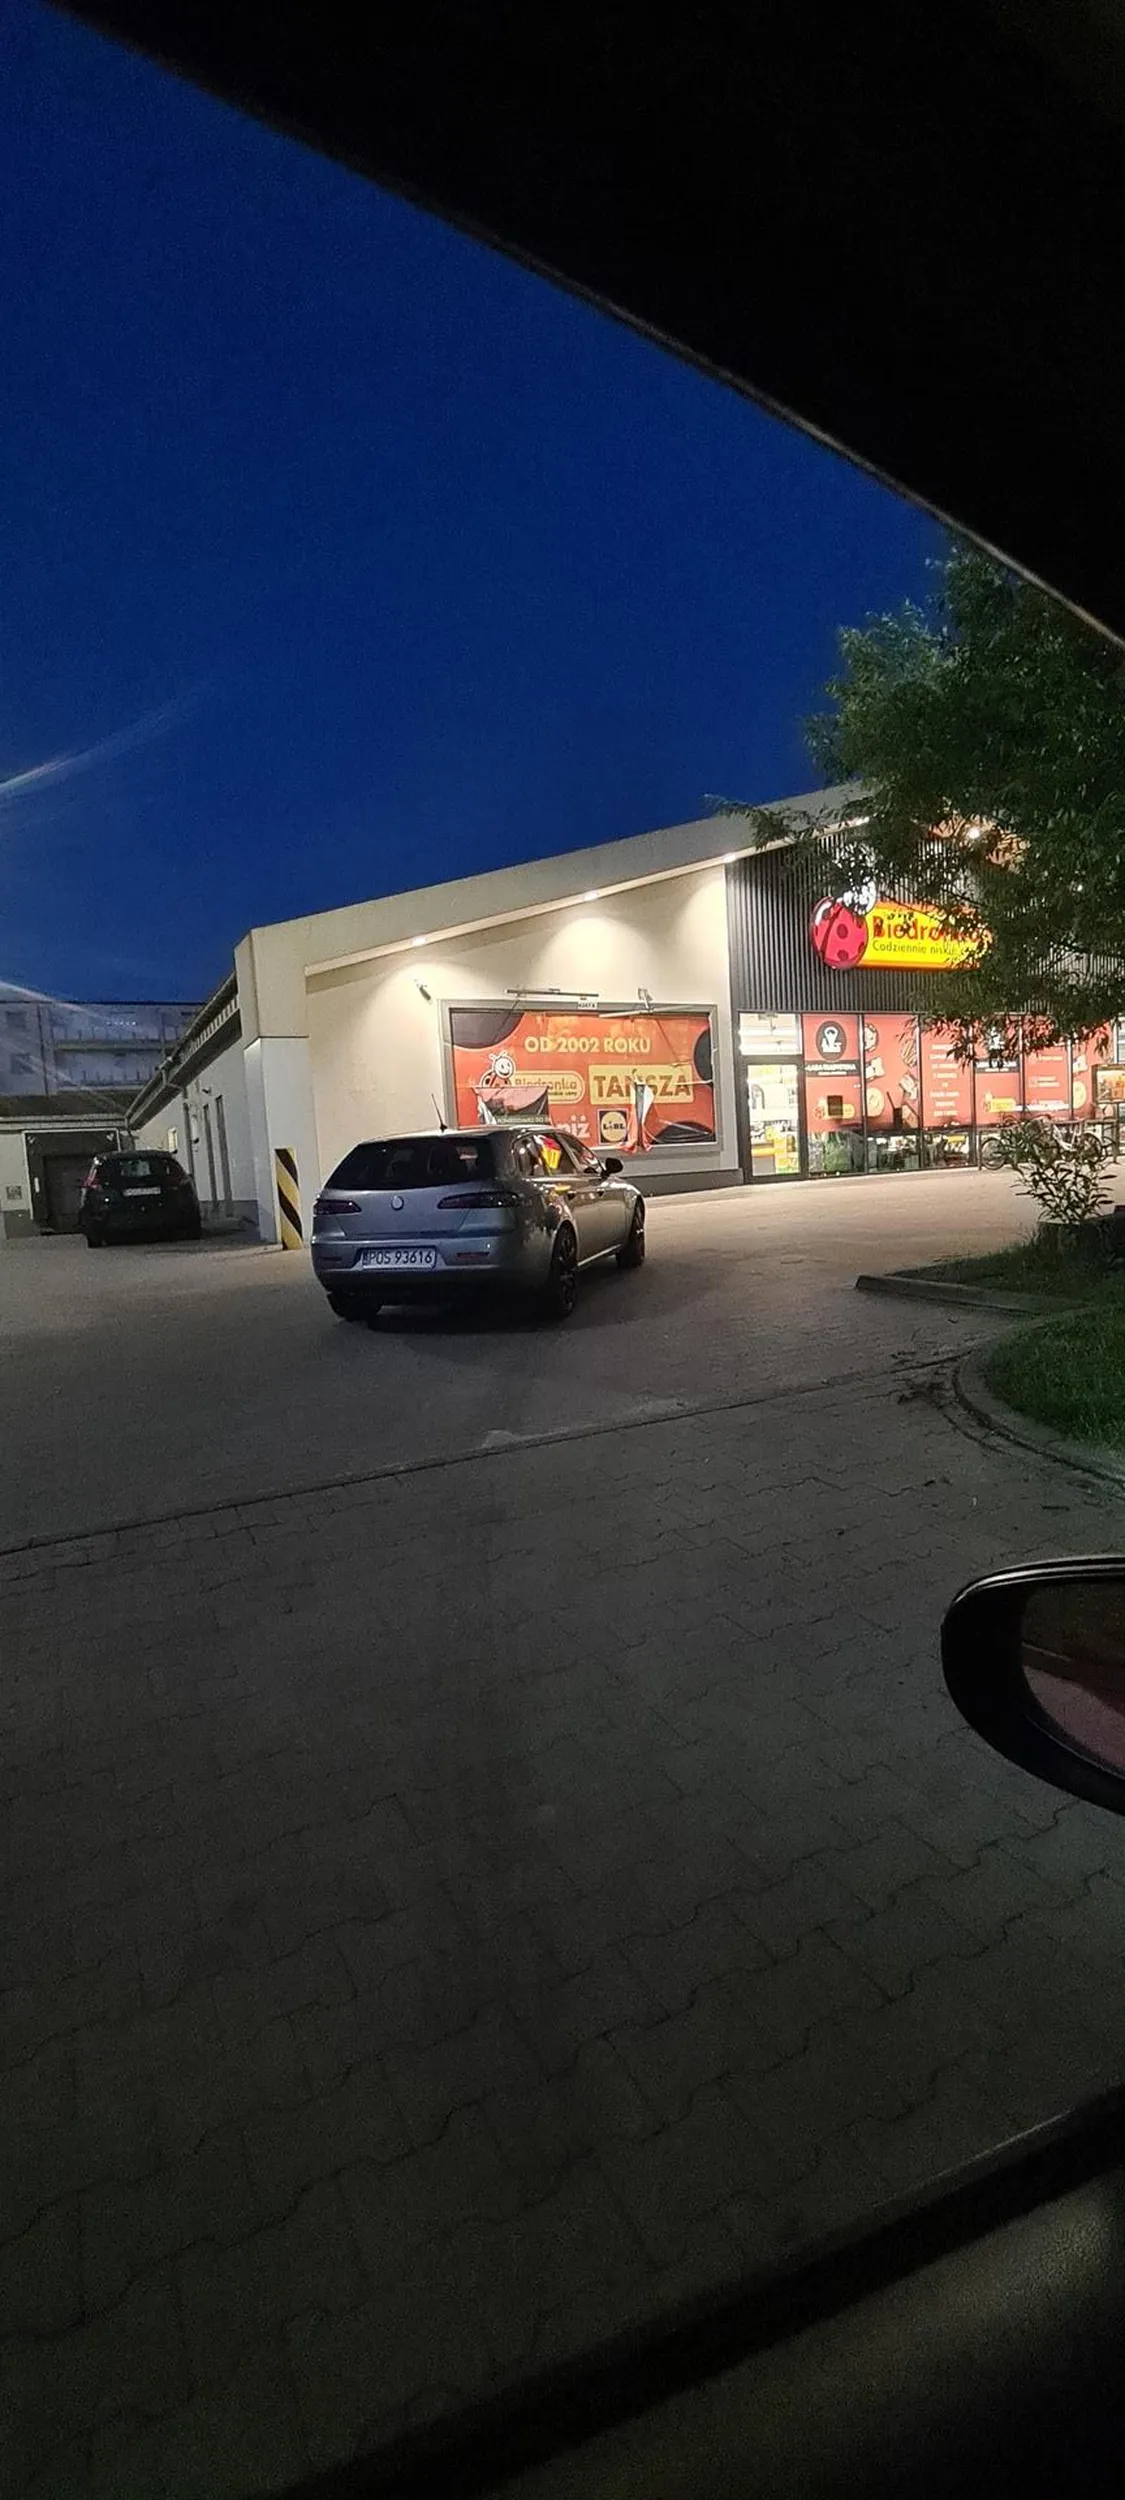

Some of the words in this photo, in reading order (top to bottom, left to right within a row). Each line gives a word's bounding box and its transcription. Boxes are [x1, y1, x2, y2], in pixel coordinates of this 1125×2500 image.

[872, 940, 926, 955] Codziennie
[524, 1036, 554, 1053] OD
[557, 1036, 600, 1053] 2002
[603, 1036, 651, 1053] ROKU
[370, 1251, 391, 1265] POS
[395, 1250, 432, 1264] 93616
